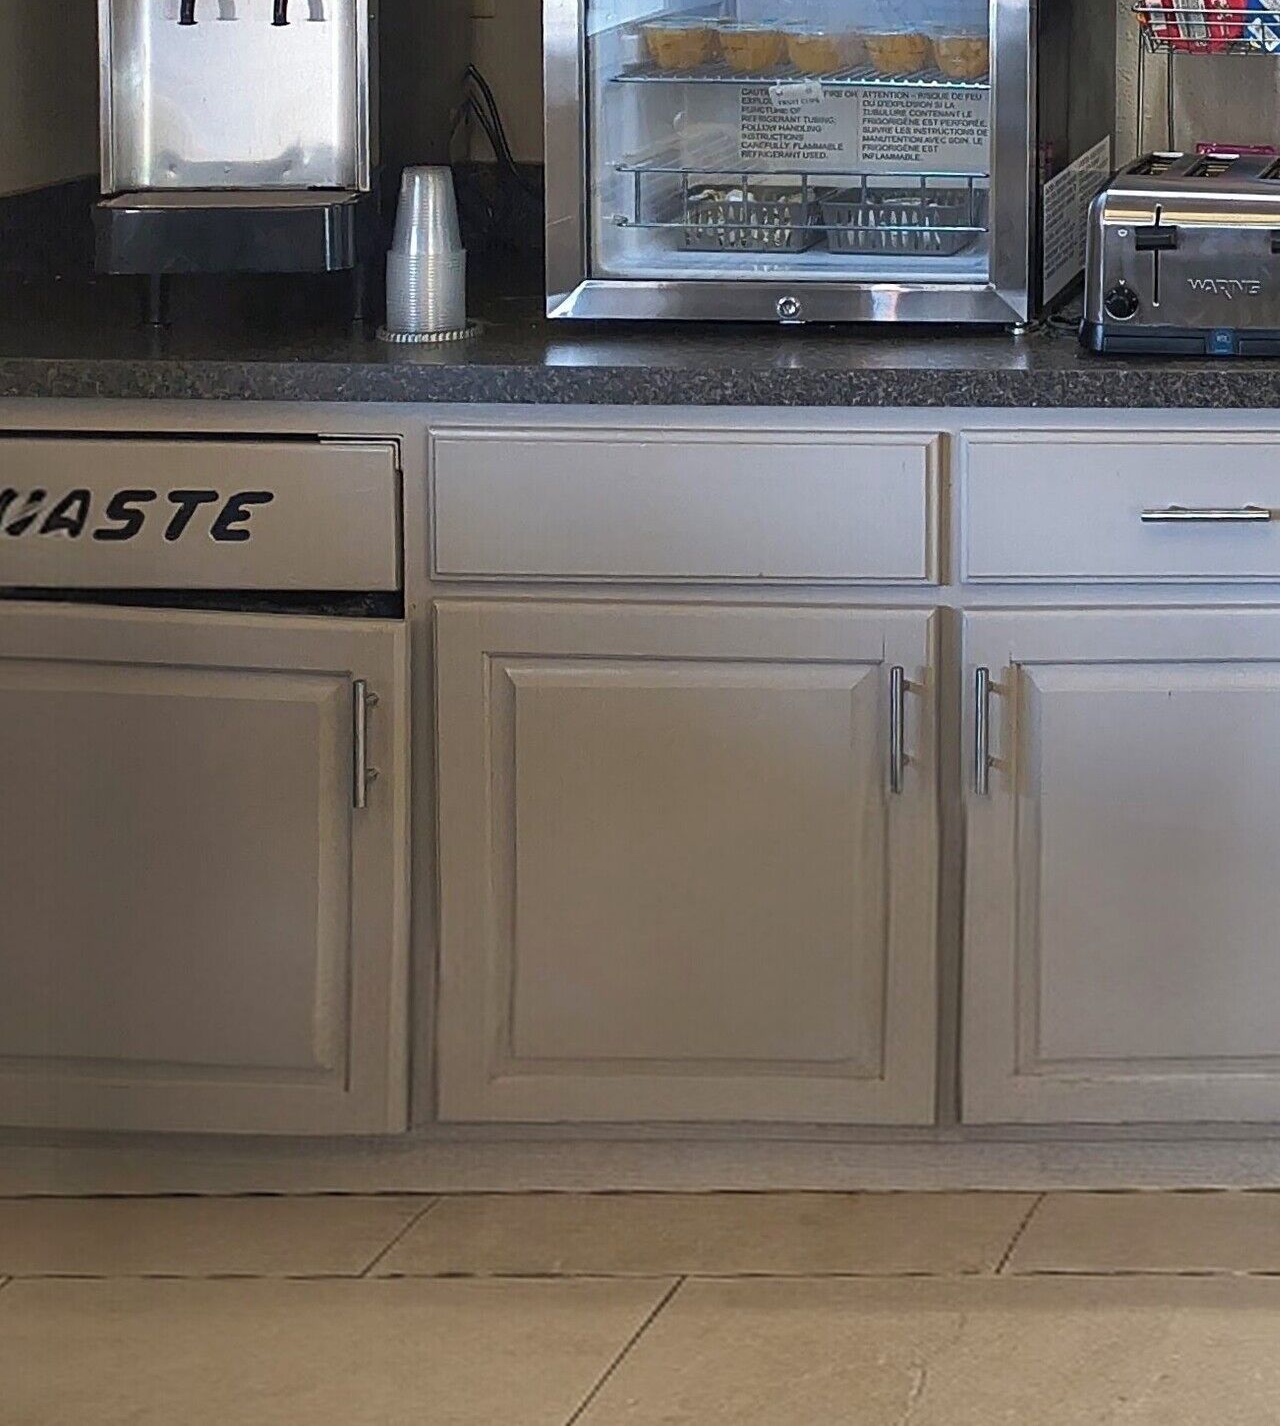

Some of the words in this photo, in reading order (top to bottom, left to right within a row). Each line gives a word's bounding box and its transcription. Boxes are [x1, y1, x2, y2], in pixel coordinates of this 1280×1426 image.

[918, 92, 949, 100] RISQUE
[909, 109, 960, 117] CONTENANT
[922, 118, 938, 126] EST
[779, 124, 822, 132] HANDLING
[914, 128, 974, 136] INSTRUCTIONS
[793, 142, 843, 150] FLAMMABLE
[922, 145, 938, 153] EST
[0, 488, 274, 542] WASTE
